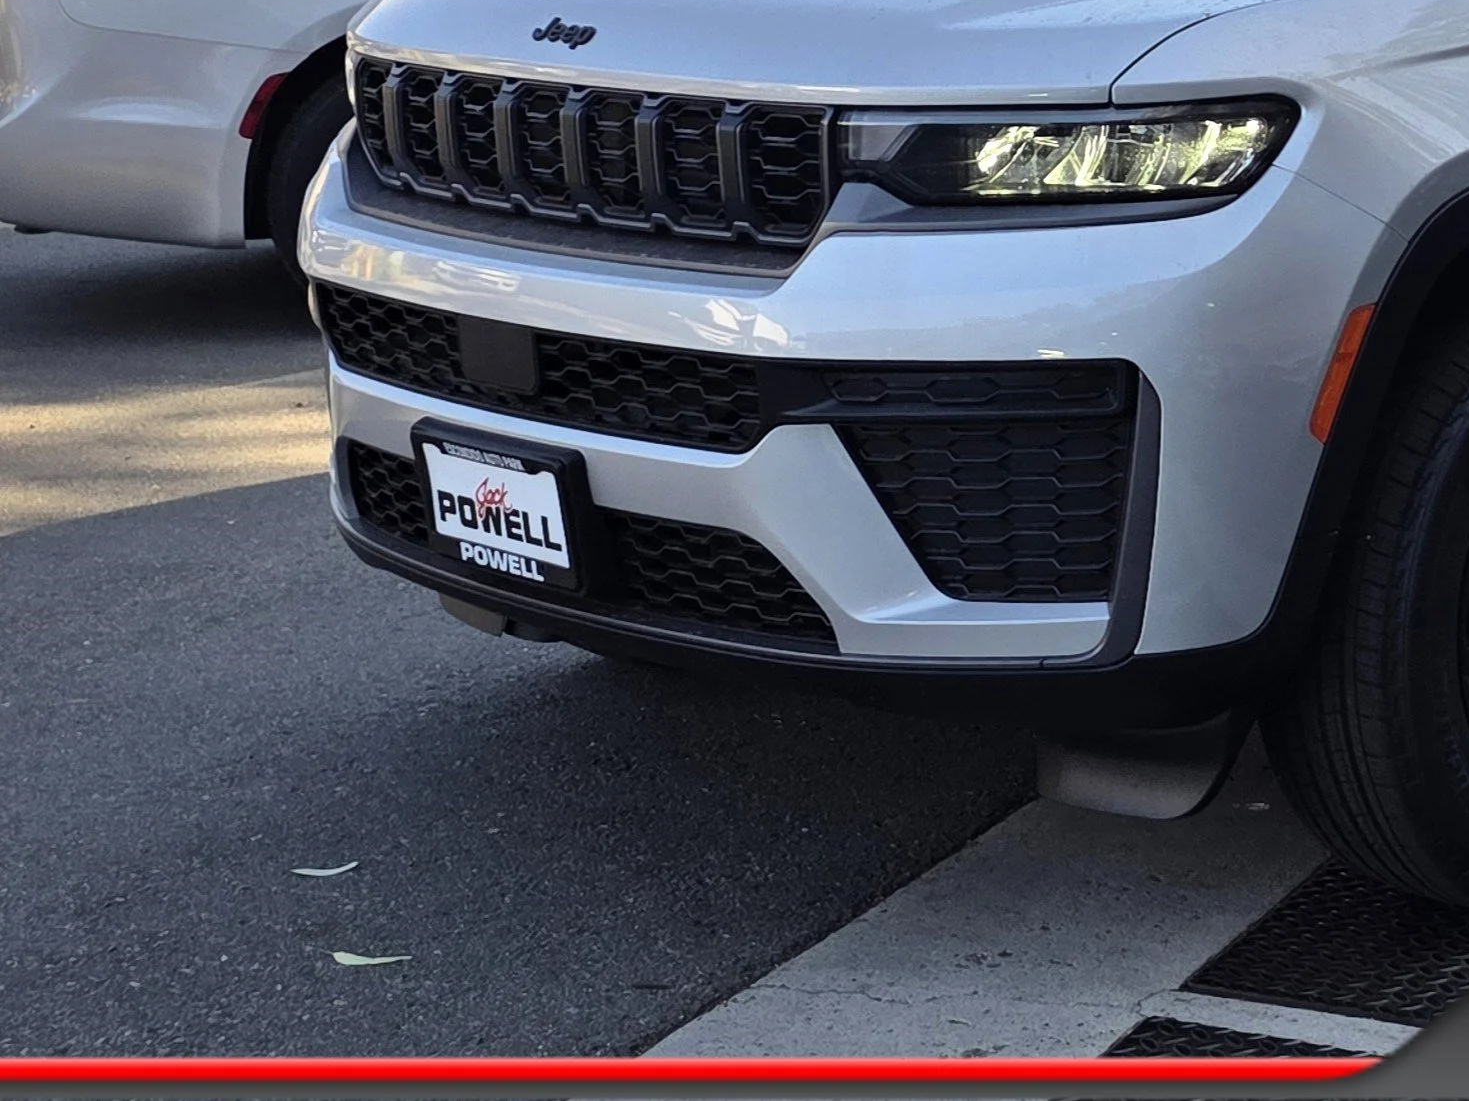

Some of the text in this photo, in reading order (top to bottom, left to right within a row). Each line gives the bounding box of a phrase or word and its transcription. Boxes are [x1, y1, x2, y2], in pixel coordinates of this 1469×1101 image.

[532, 17, 597, 50] Jeep
[475, 477, 513, 518] Jack
[437, 489, 562, 552] POWELL
[459, 541, 545, 582] POWELL
